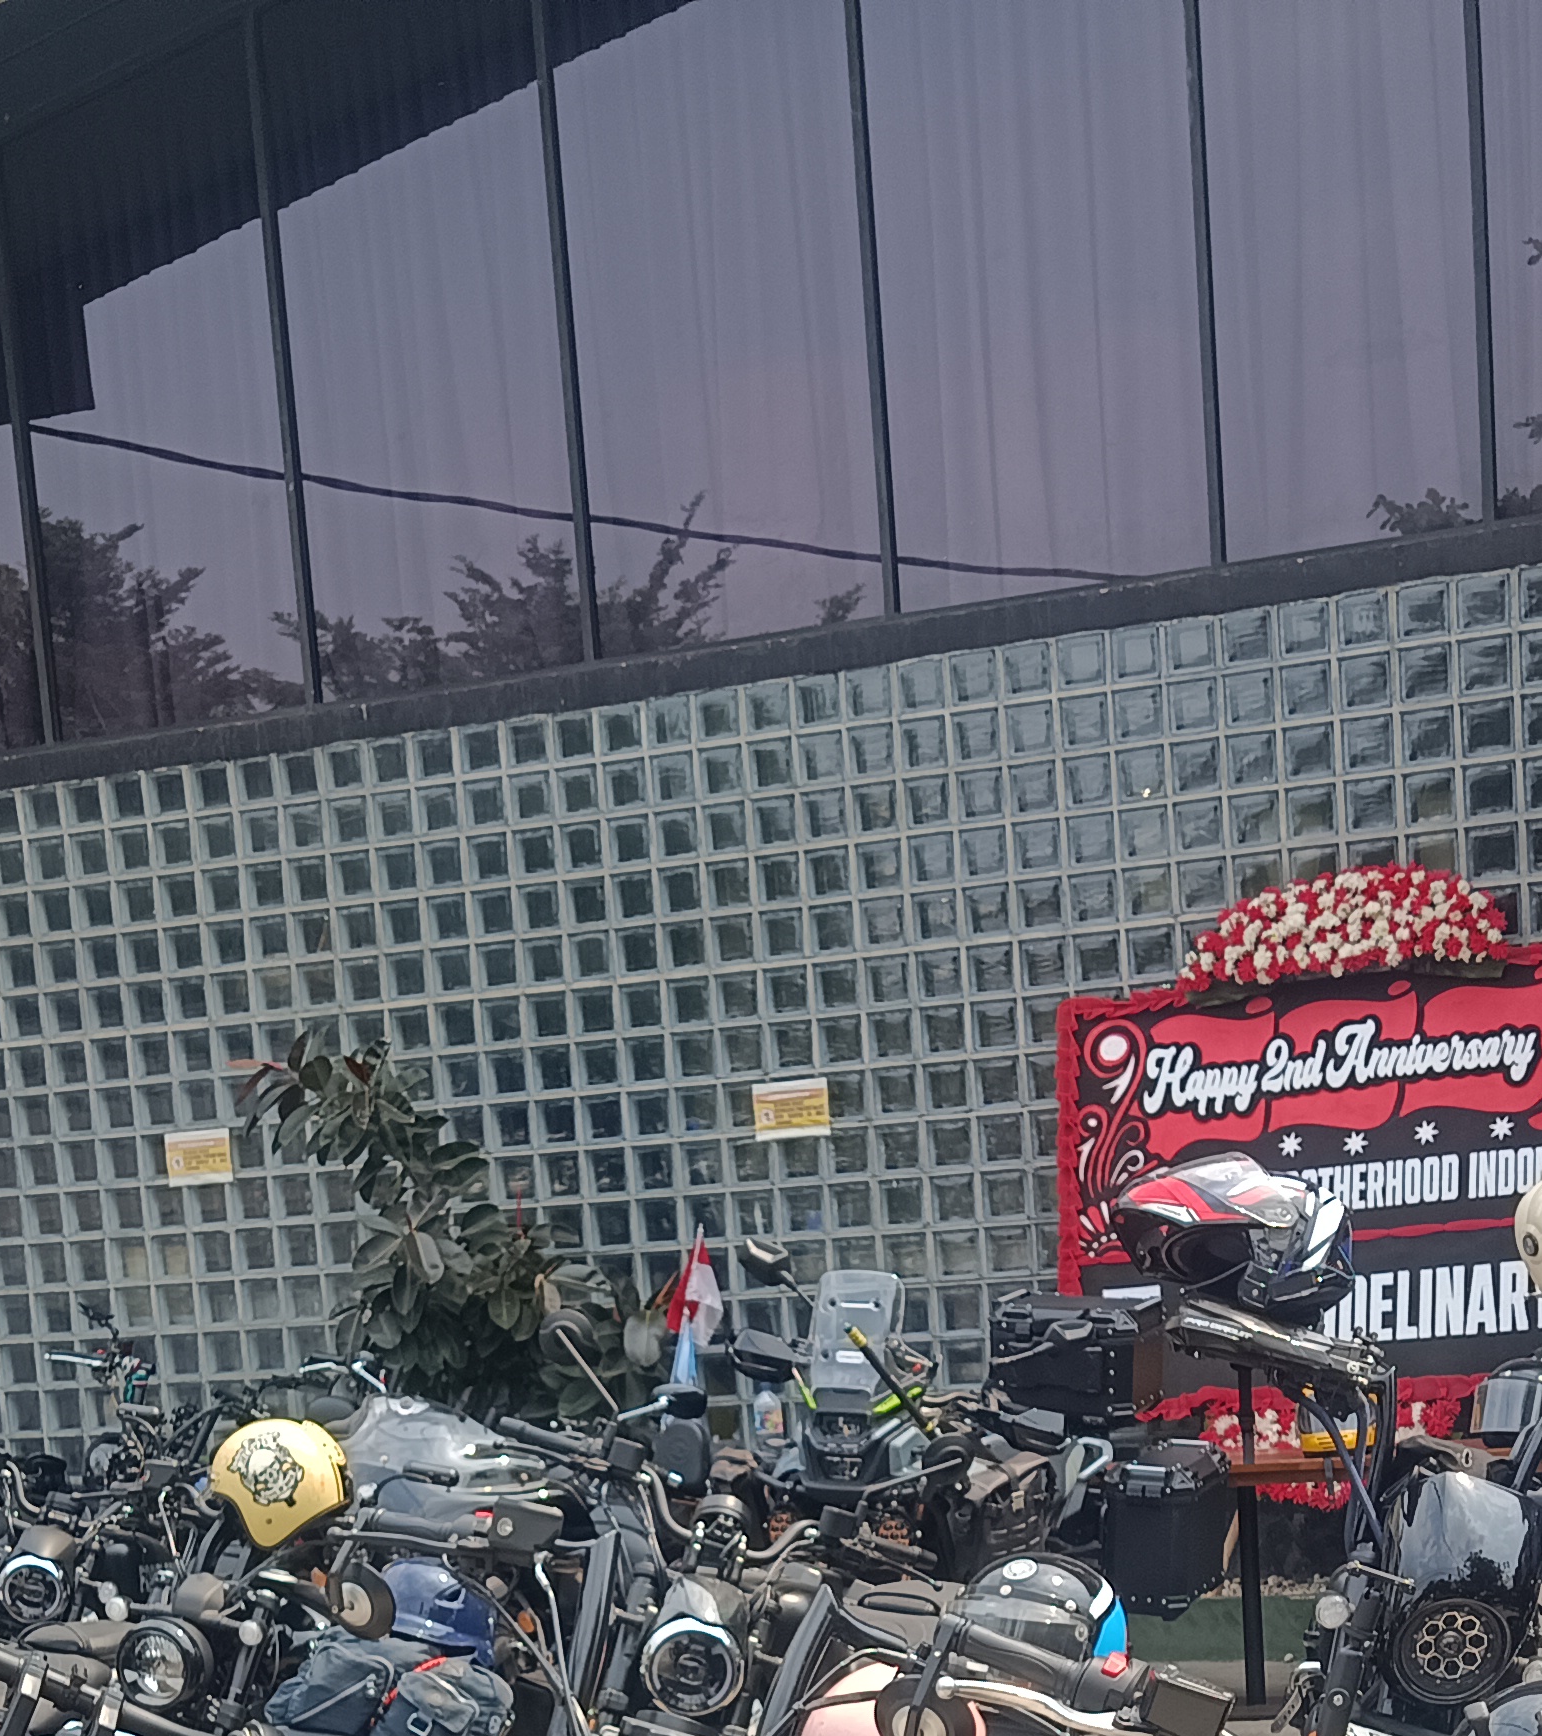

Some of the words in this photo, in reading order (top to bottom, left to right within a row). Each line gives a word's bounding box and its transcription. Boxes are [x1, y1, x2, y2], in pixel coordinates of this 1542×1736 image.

[1143, 1043, 1261, 1115] Happy
[1261, 1037, 1326, 1094] 2nd
[1325, 1018, 1540, 1090] Anniversary
[1287, 1153, 1460, 1211] THERHOOD
